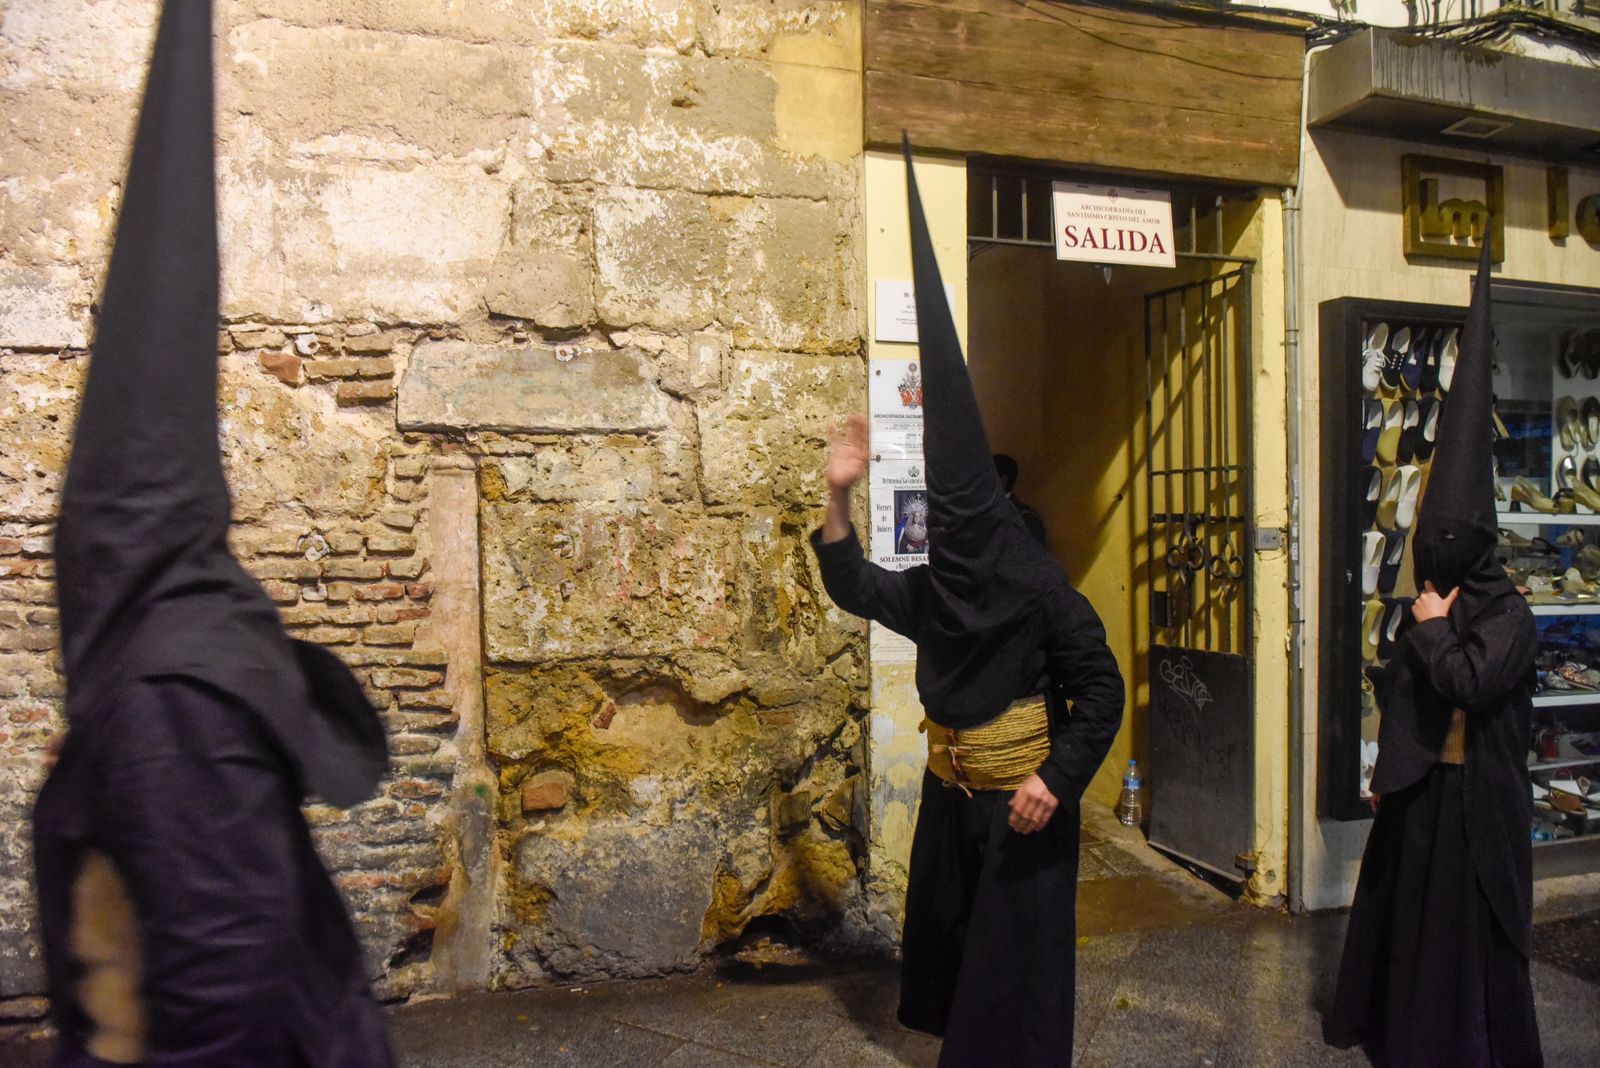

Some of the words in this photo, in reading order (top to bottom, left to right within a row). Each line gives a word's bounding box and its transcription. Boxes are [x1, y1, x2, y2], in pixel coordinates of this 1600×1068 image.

[1067, 210, 1103, 219] SANTÍSIMO
[1080, 203, 1134, 215] ARCHICOFRADÍA
[1064, 224, 1167, 254] SALIDA
